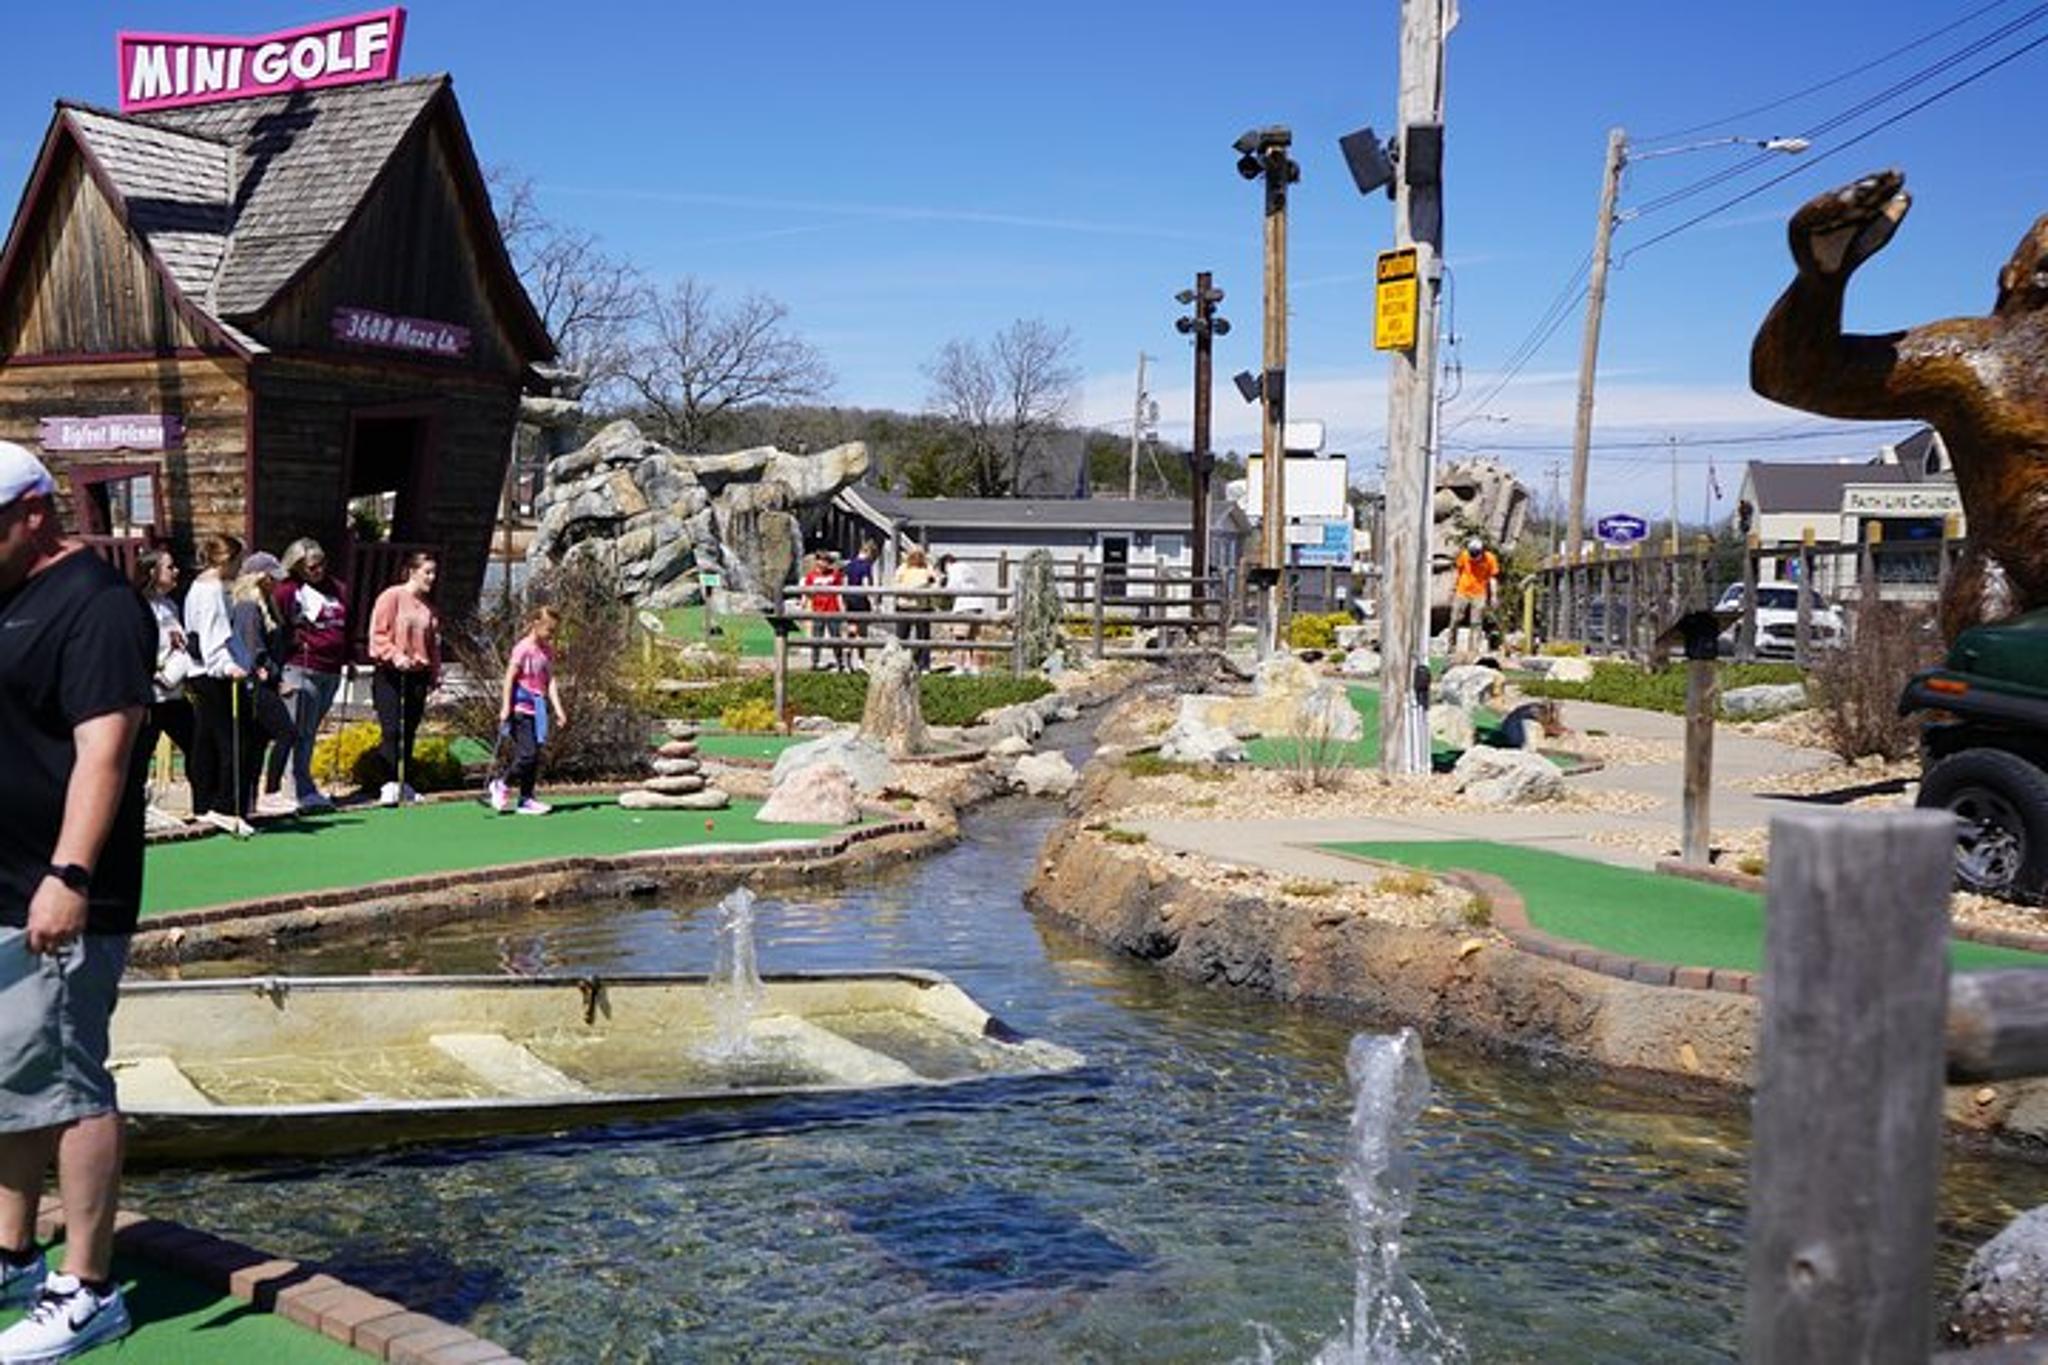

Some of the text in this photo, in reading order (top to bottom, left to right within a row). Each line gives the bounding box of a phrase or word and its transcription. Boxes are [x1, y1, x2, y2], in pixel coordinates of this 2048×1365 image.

[128, 22, 388, 100] MINI GOLF
[1852, 494, 1881, 508] FAITH
[1909, 494, 1957, 508] CHURCH
